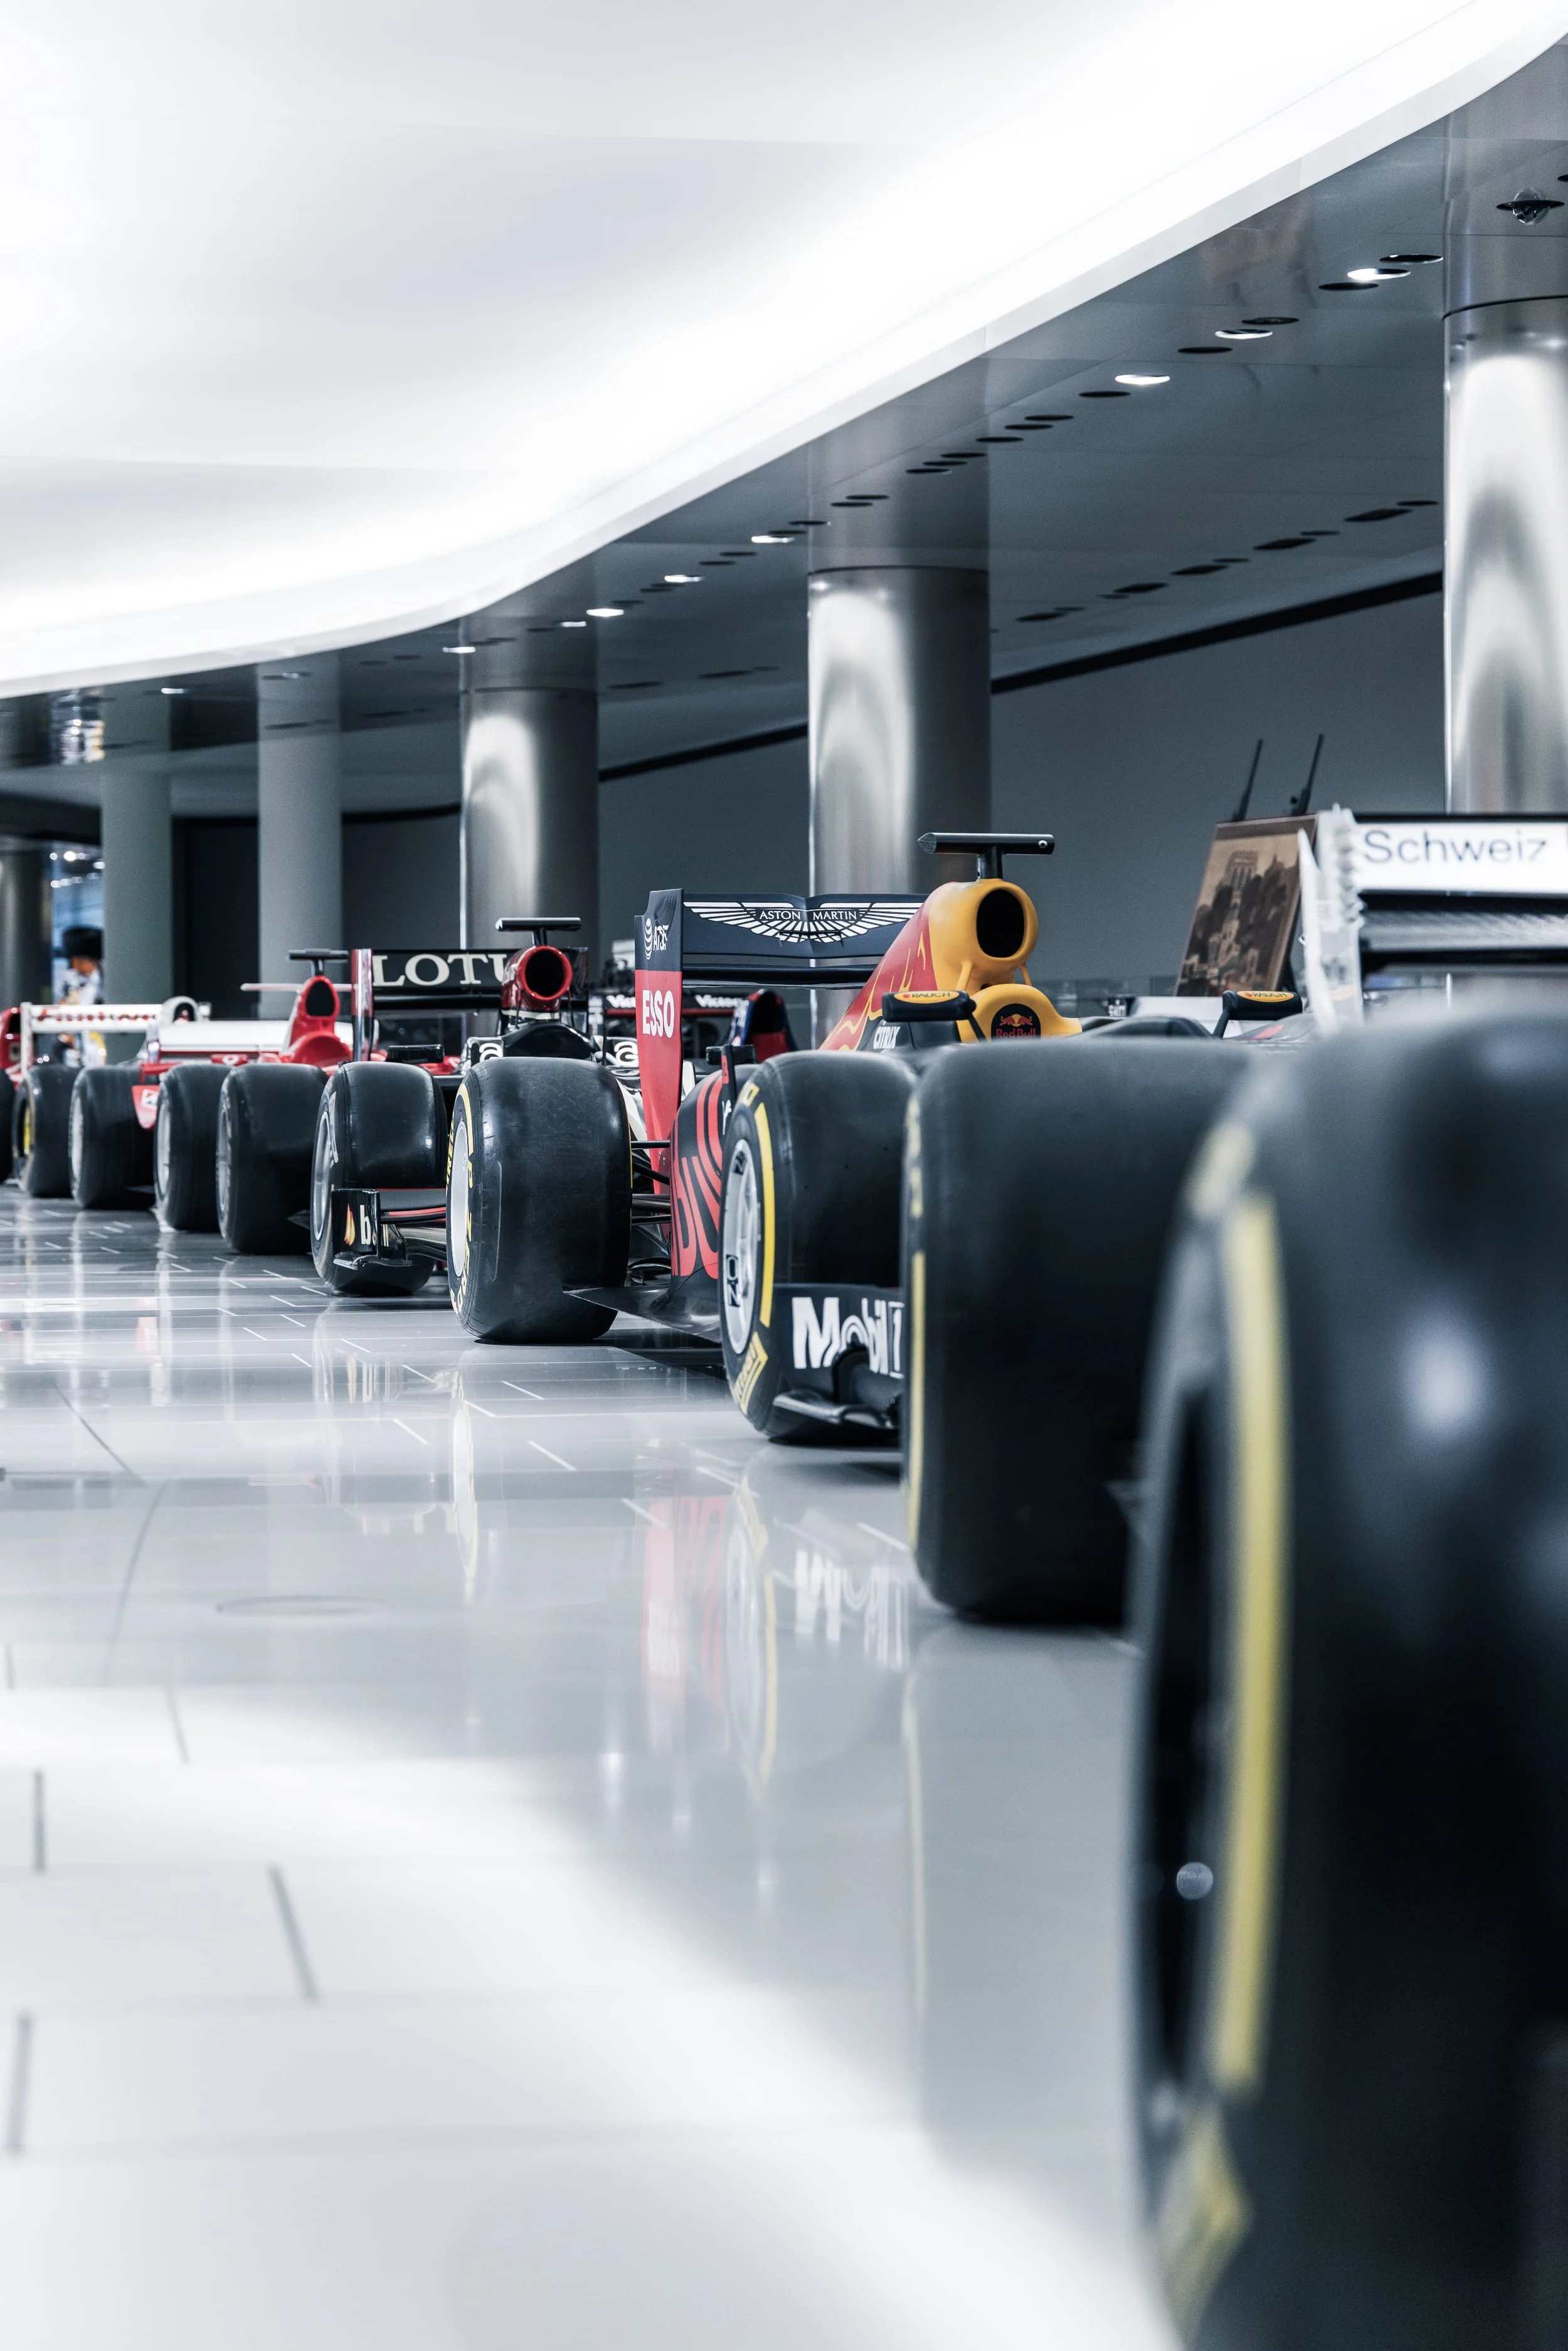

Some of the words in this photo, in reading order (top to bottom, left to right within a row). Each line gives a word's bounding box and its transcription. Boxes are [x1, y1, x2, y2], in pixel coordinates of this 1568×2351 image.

[1364, 829, 1548, 863] Schweiz
[760, 911, 801, 920] ASTON
[813, 911, 857, 920] MARTIN
[996, 1028, 1015, 1038] Red
[1017, 1028, 1036, 1038] Bull
